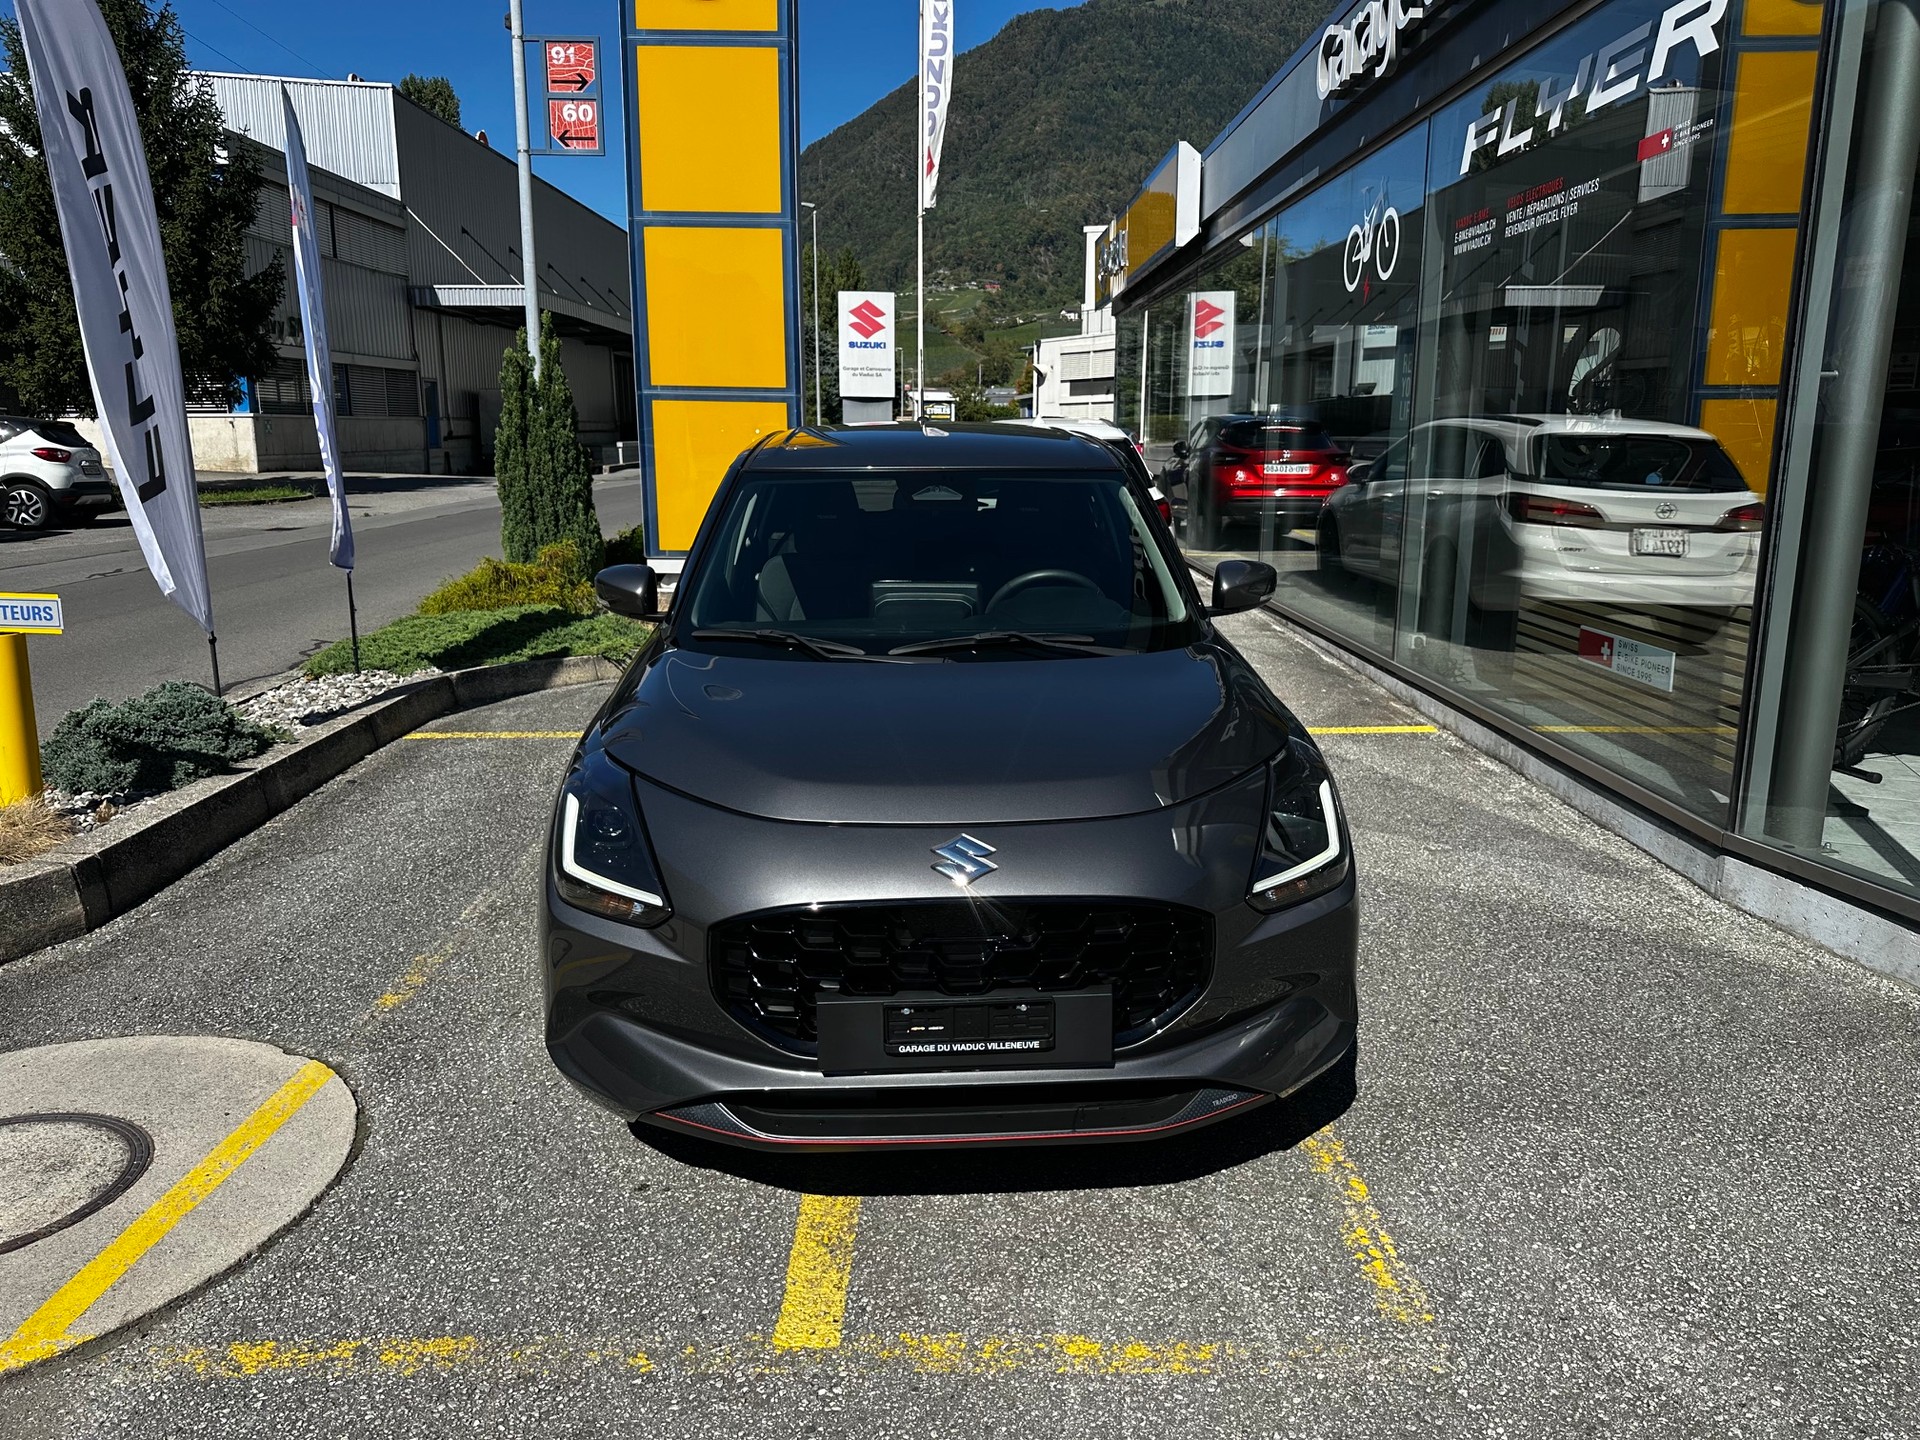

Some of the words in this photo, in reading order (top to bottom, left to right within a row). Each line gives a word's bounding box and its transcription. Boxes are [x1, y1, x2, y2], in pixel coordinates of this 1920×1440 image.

[551, 46, 575, 65] 91
[1459, 0, 1727, 175] FLYER
[562, 104, 593, 122] 60
[1674, 128, 1691, 140] E-BIKE
[1691, 118, 1714, 132] PIONEER
[1675, 120, 1691, 131] SWISS
[1673, 137, 1688, 148] SINCE
[1688, 132, 1701, 143] 1995
[1506, 208, 1523, 224] VENTE
[1569, 177, 1600, 200] SERVICES
[1505, 218, 1535, 238] REVENDEUR
[1535, 210, 1559, 227] OFFICIEL
[1560, 202, 1578, 218] FLYER
[848, 341, 886, 349] SUZUKI
[1617, 640, 1639, 653] SWISS
[1617, 651, 1639, 666] E-BIKE
[1640, 658, 1670, 675] PIONEER
[1616, 663, 1636, 677] SINCE
[1636, 670, 1653, 683] 1995
[898, 1044, 936, 1054] GARAGE
[937, 1043, 951, 1052] DU
[952, 1042, 985, 1052] VIADUC
[986, 1040, 1040, 1051] VILLENEUVE
[1212, 1093, 1238, 1107] TRADIZIO
